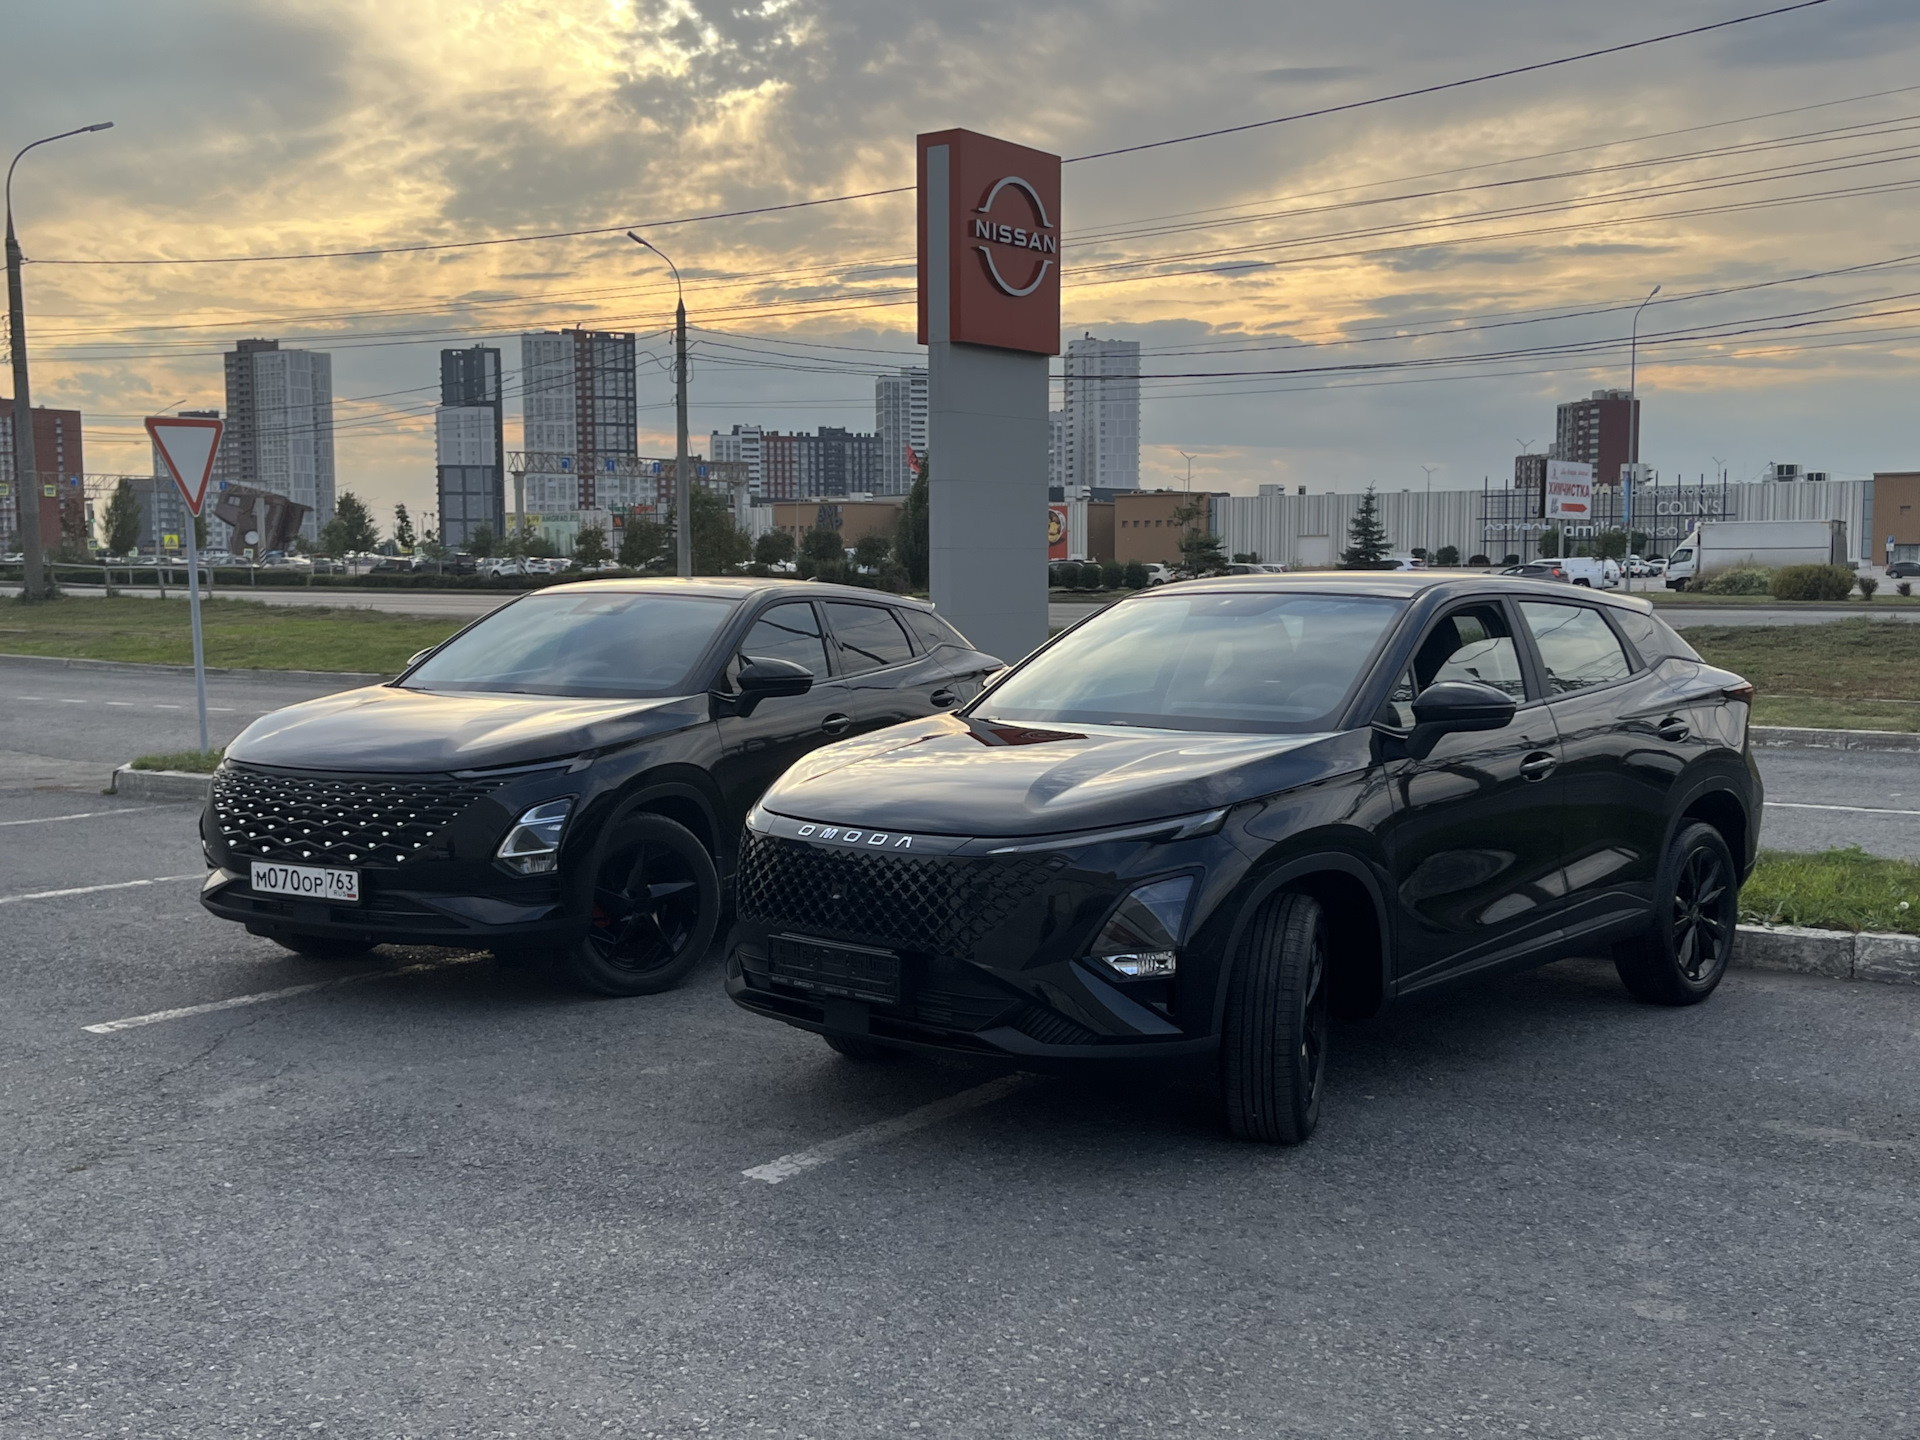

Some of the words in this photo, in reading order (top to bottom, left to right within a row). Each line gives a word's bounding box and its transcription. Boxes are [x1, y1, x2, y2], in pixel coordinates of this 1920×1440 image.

[975, 218, 1057, 254] NISSAN
[1548, 481, 1591, 497] ХИМЧИСТКА
[1656, 500, 1721, 516] COLIN'S
[797, 824, 913, 849] OMODA
[327, 872, 354, 892] 763
[333, 889, 347, 898] RUS
